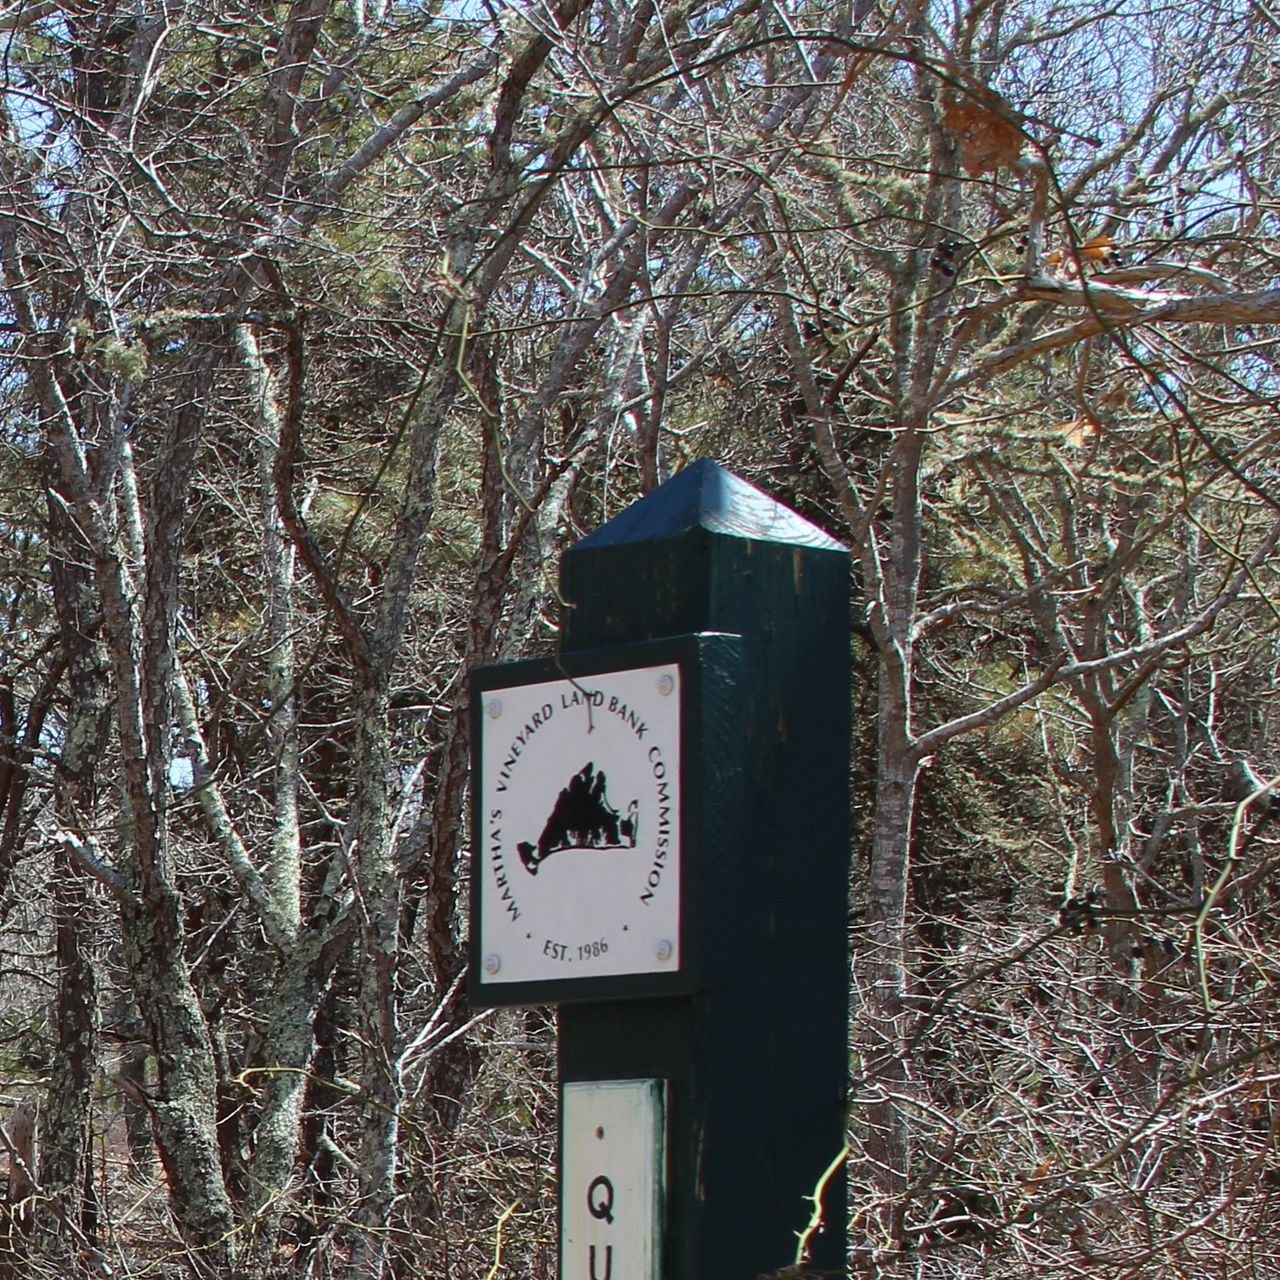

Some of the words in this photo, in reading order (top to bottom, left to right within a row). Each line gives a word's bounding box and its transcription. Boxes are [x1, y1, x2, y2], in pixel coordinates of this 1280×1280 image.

[497, 703, 553, 792] VINEYARD
[608, 696, 648, 740] BANK
[489, 809, 521, 921] MARTHA'S
[639, 746, 671, 906] COMMISSION
[543, 940, 572, 962] EST.
[577, 938, 609, 961] 1986
